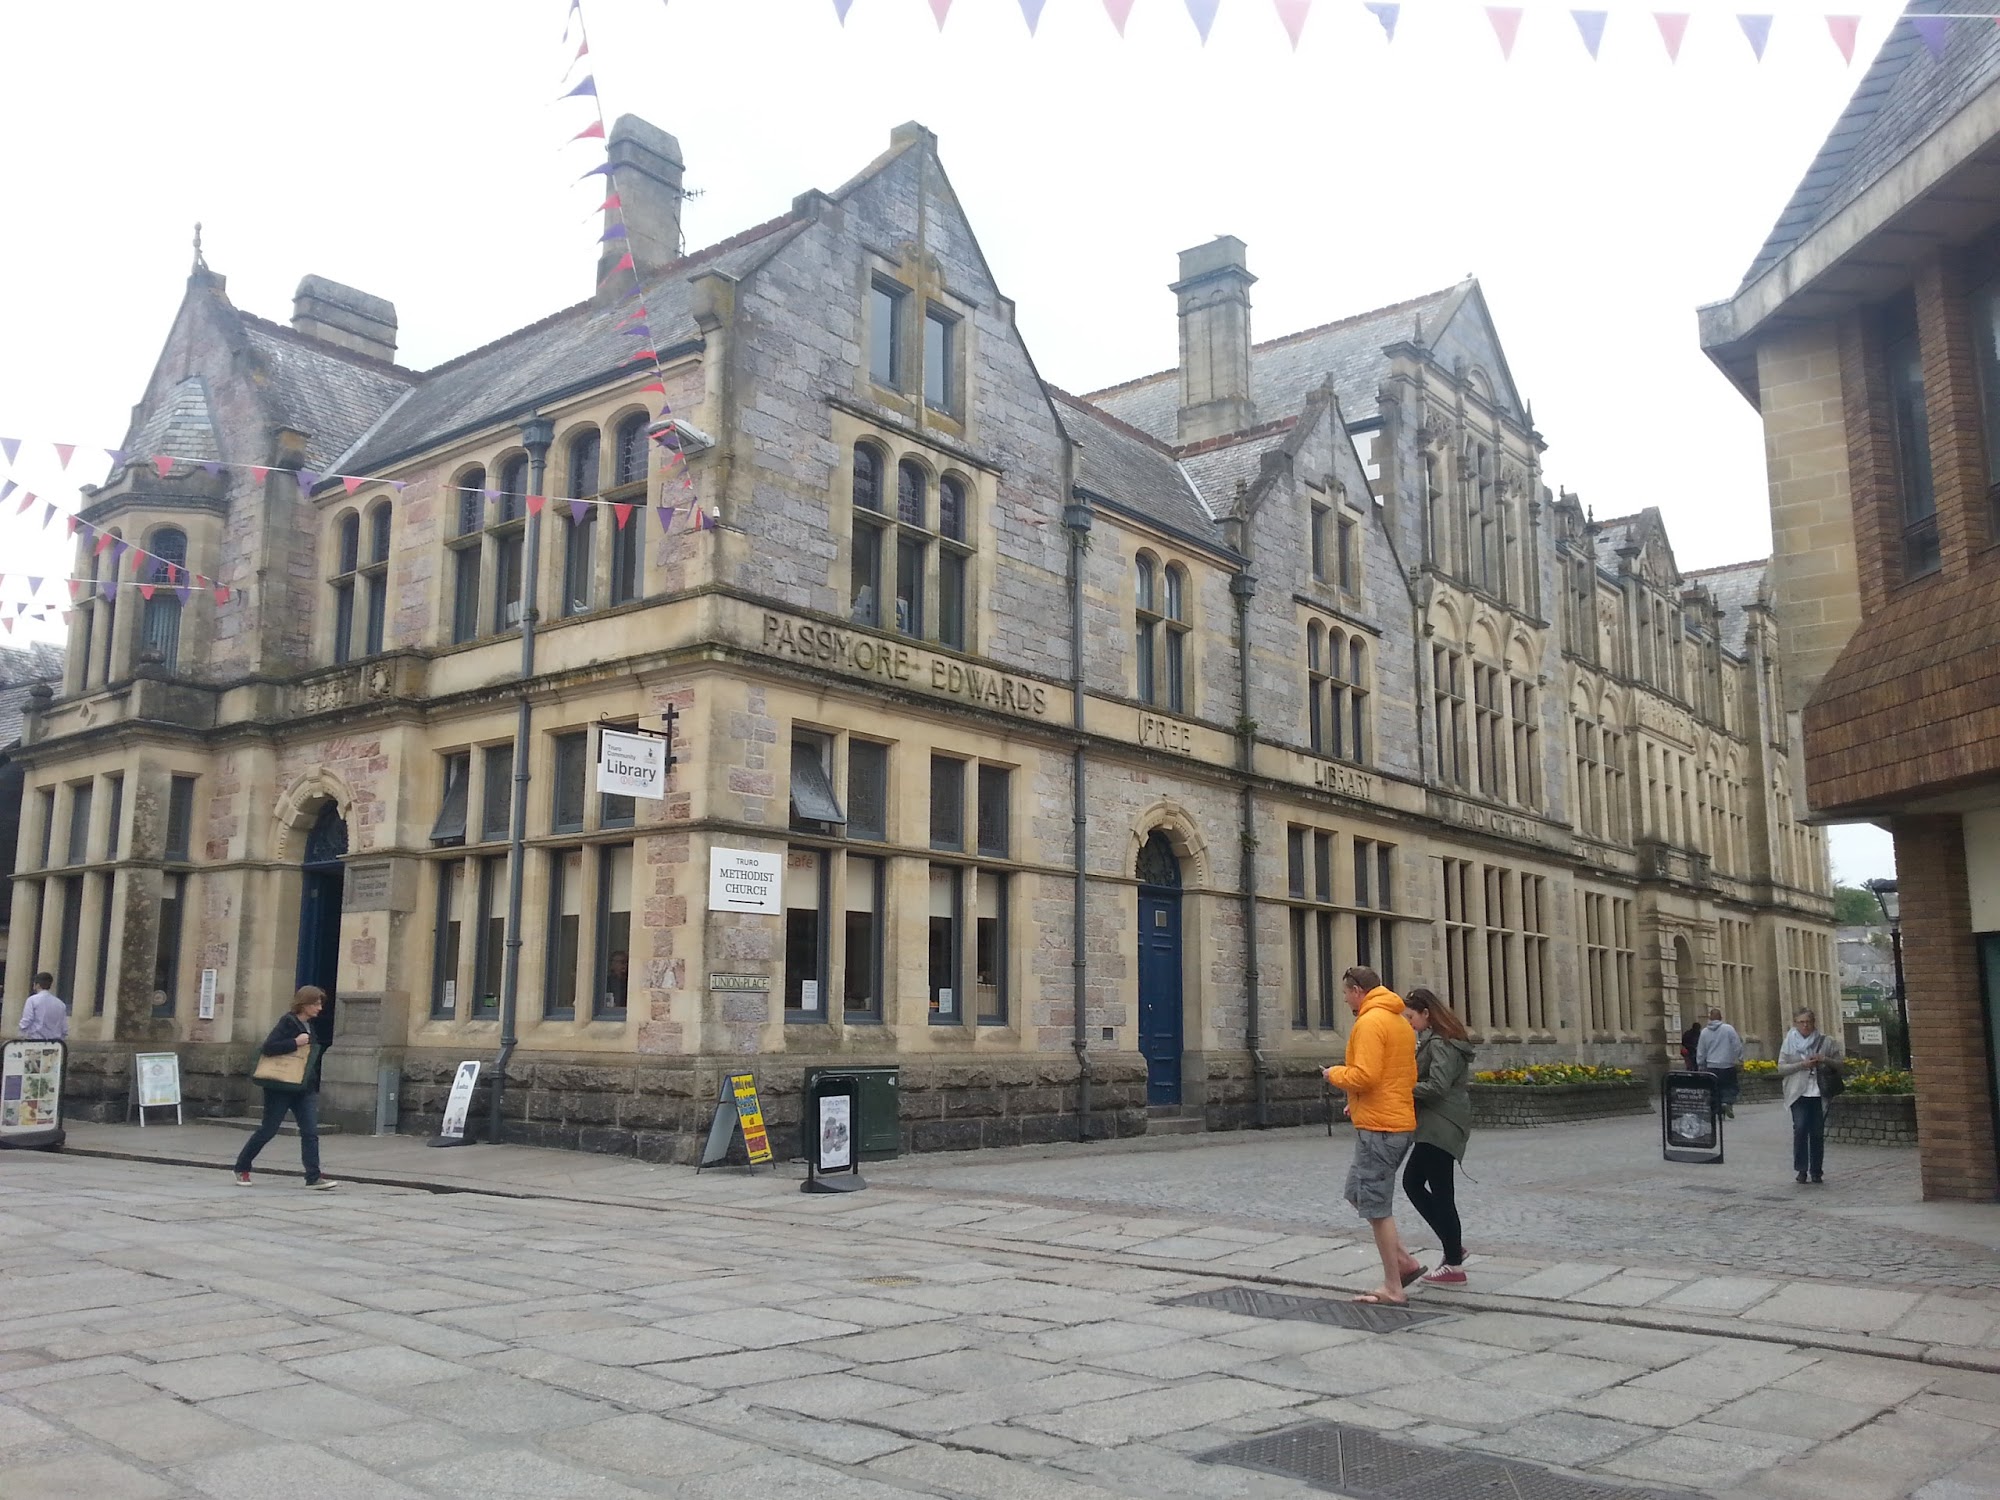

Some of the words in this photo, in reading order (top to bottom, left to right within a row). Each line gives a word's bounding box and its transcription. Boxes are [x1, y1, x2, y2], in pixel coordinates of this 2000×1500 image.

[763, 613, 909, 681] PASSMORE
[931, 658, 1046, 715] EDWARDS
[1143, 717, 1192, 752] FREE
[608, 744, 623, 752] Truro
[607, 750, 637, 761] Community
[607, 758, 657, 783] Library
[1314, 762, 1373, 797] LIBRARY
[736, 857, 760, 867] TRURO
[719, 867, 775, 883] METHODIST
[725, 883, 768, 896] CHURCH
[714, 976, 741, 988] UNION
[743, 977, 768, 989] PLACE
